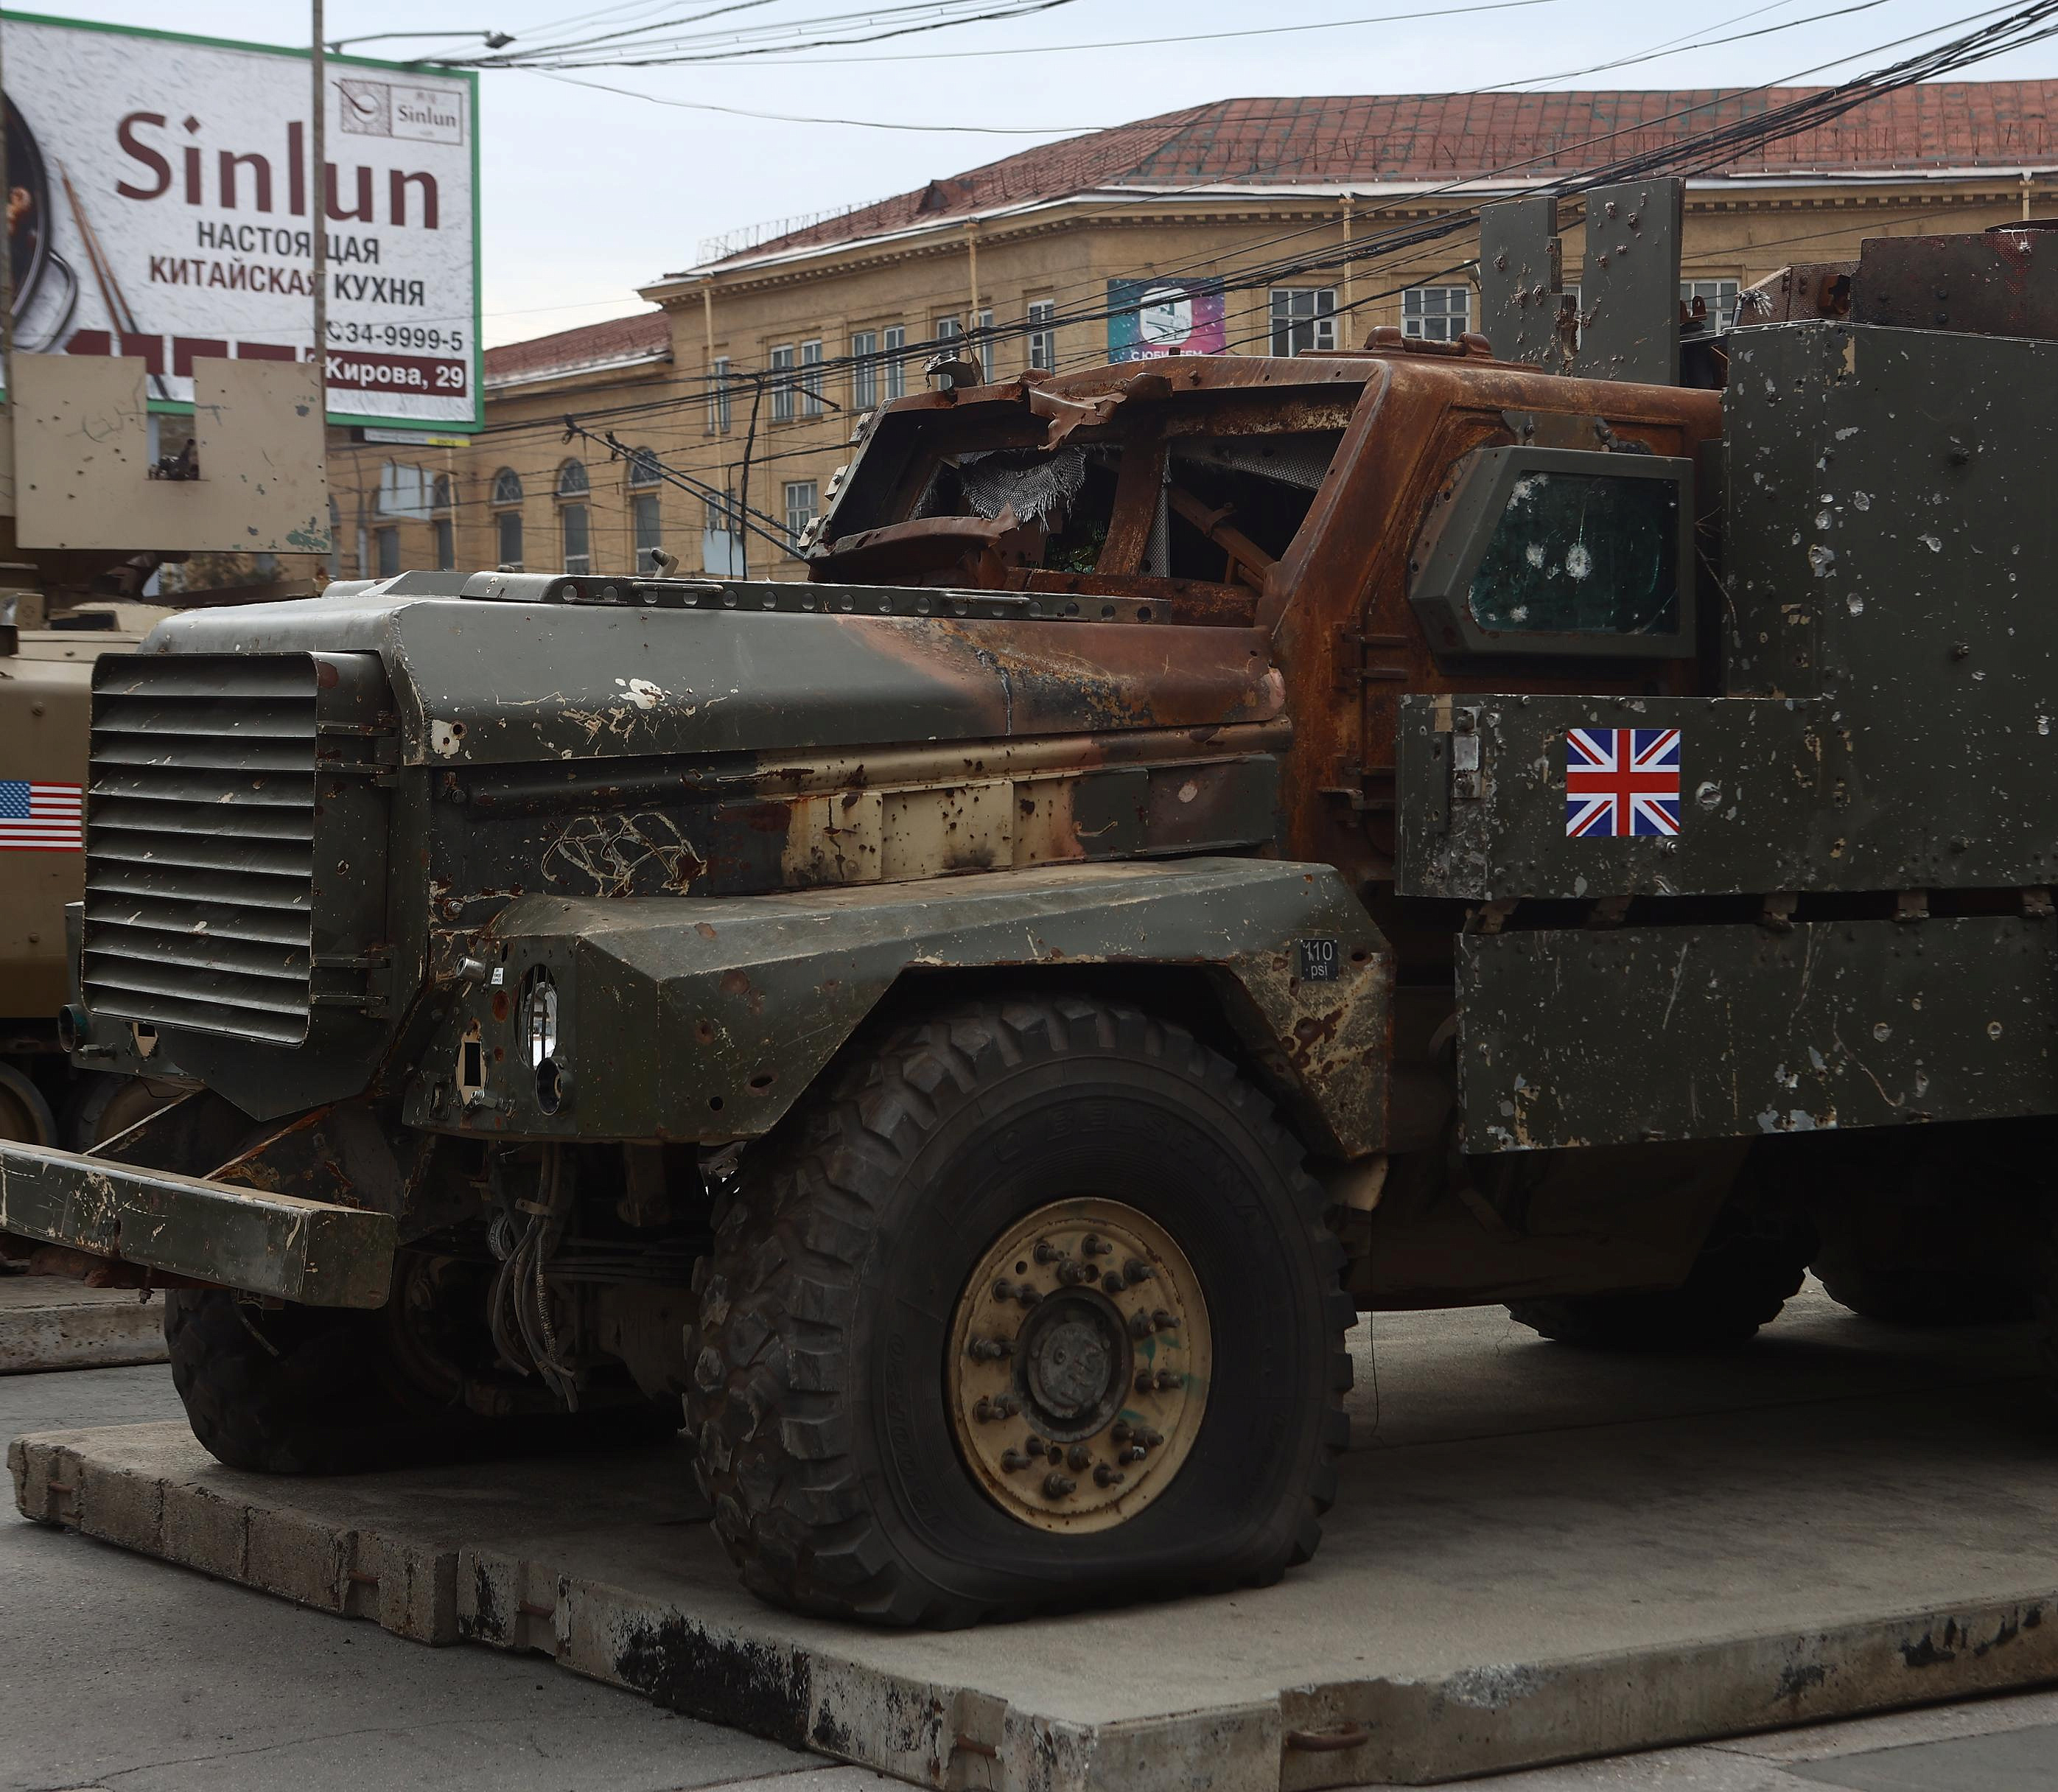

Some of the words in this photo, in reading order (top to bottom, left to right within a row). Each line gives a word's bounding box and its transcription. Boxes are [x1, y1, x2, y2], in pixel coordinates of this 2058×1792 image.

[398, 105, 457, 127] Sinlun
[116, 111, 439, 230] Sinlun
[335, 273, 424, 307] КУХНЯ
[346, 322, 463, 351] 34-9999-5
[1142, 350, 1203, 359] ЮБИЕЕМ
[326, 356, 429, 390] Кирова,
[435, 365, 465, 389] 29
[1304, 941, 1333, 962] 110
[1311, 962, 1328, 979] psi
